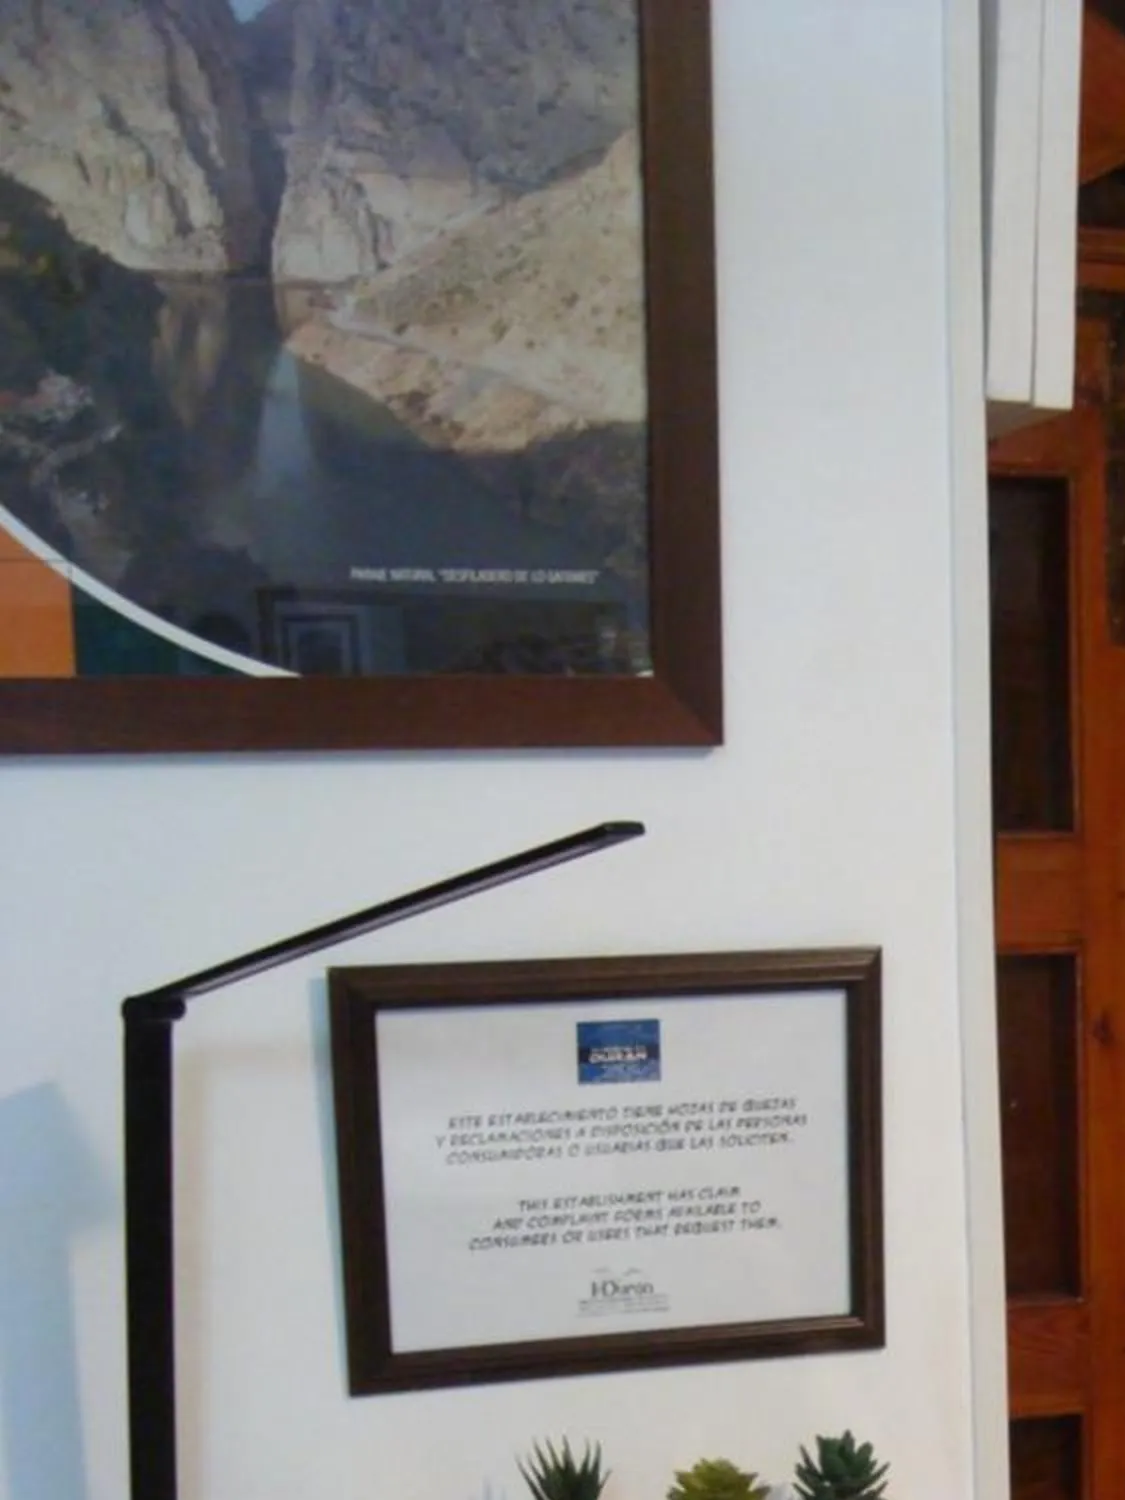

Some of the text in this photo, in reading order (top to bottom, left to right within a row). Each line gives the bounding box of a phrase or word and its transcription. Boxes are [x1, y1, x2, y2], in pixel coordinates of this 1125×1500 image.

[449, 1114, 482, 1129] ESTE
[487, 1106, 618, 1127] ESTABLECIMIENTO
[436, 1135, 446, 1148] Y
[449, 1127, 571, 1147] RECLAMACIONES
[685, 1119, 703, 1133] DE
[708, 1117, 731, 1131] LAS
[655, 1138, 684, 1151] QUE
[689, 1136, 714, 1150] LAS
[553, 1190, 663, 1210] ESTABLISHMENT
[667, 1188, 696, 1201] HAS
[525, 1211, 609, 1229] COMPLAINT
[741, 1200, 761, 1214] TO
[562, 1230, 583, 1244] OR
[674, 1219, 735, 1236] REQUEST
